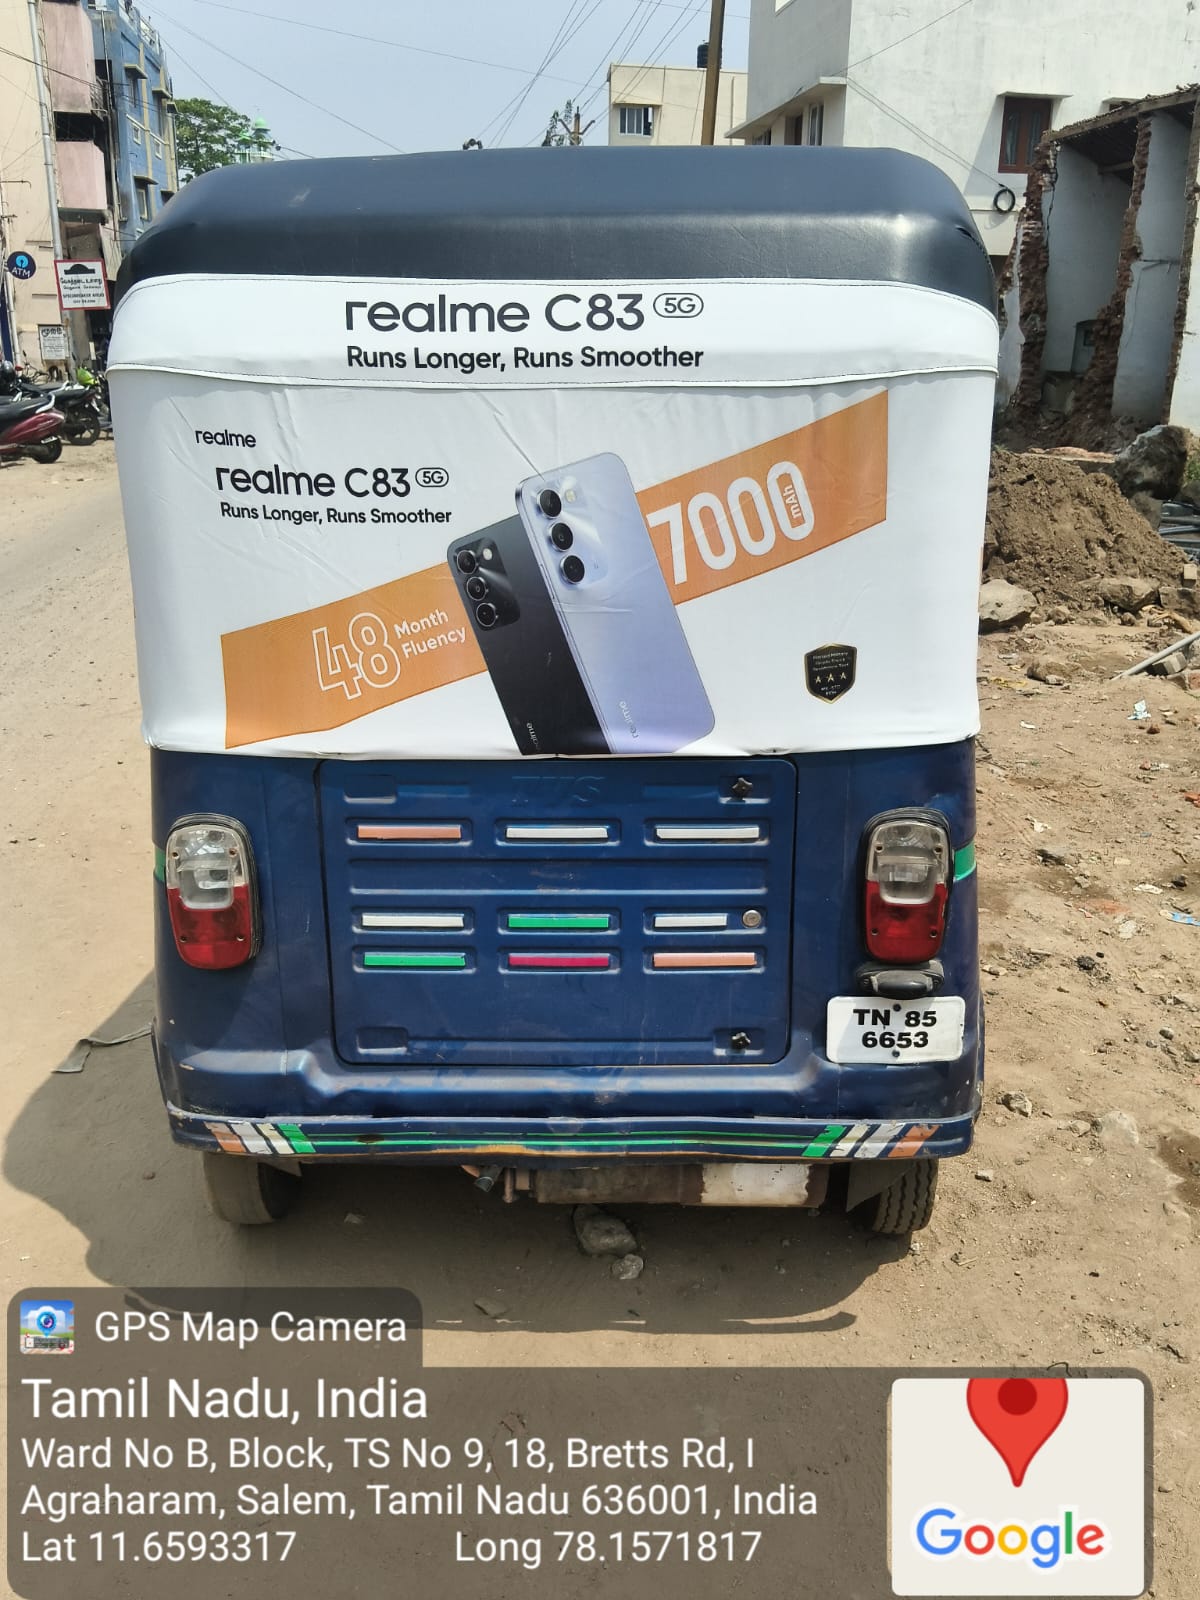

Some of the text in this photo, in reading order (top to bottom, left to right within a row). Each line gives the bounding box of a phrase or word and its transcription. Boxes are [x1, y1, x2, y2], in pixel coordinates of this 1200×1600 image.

[11, 266, 31, 278] ATM
[345, 293, 696, 333] realme C83 5G
[346, 345, 704, 374] Runs Longer, Runs Smoother
[195, 429, 257, 448] realme
[215, 464, 444, 498] realme C83 5G
[220, 501, 452, 526] Runs Longer, Runs Smoother
[782, 483, 802, 519] mAh
[645, 460, 815, 586] 7000
[393, 608, 449, 639] Month
[312, 612, 401, 700] 48
[401, 626, 467, 659] Fluency
[853, 1008, 937, 1028] TN 85
[861, 1031, 929, 1049] 6653
